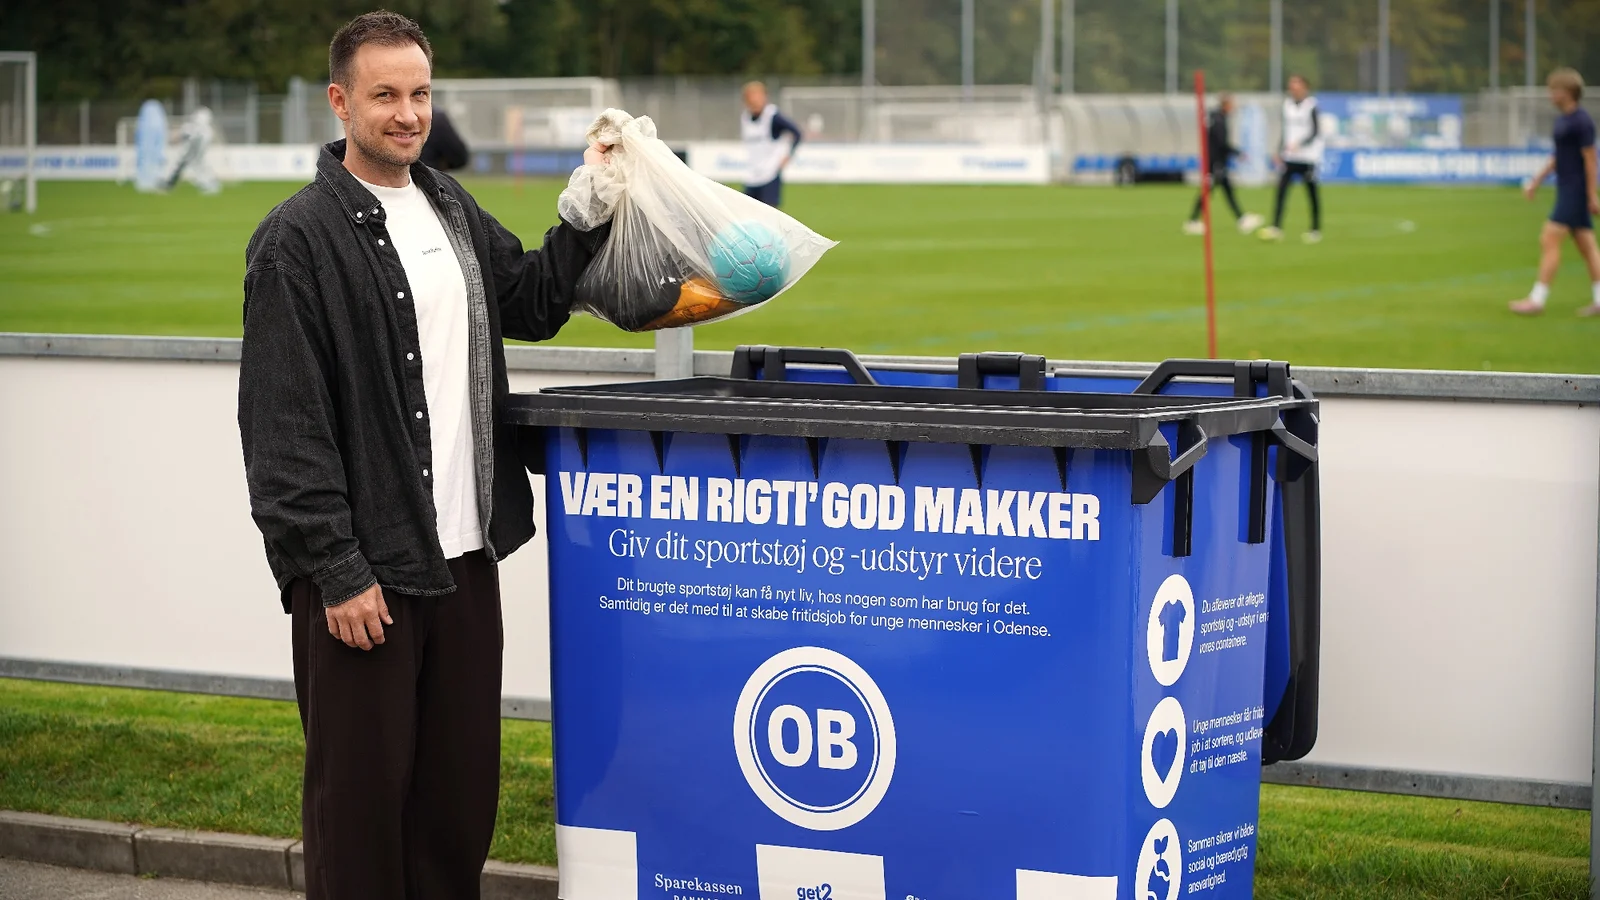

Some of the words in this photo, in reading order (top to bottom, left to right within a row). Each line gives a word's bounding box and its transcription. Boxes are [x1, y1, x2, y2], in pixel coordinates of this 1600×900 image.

[558, 471, 643, 519] VÆR
[650, 474, 699, 521] EN
[821, 481, 906, 531] GOD
[914, 485, 1100, 541] MAKKER
[609, 528, 650, 559] Giv
[655, 530, 689, 561] dit
[693, 538, 807, 574] sportstøj
[812, 545, 845, 575] og
[850, 542, 949, 581] -udstyr
[954, 546, 1042, 580] videre
[617, 577, 634, 592] Dit
[637, 578, 676, 597] brugte
[679, 583, 732, 601] sportstøj
[735, 584, 757, 599] kan
[760, 585, 772, 600] få
[776, 588, 796, 604] nyt
[799, 587, 815, 605] liv,
[818, 589, 841, 604] hos
[845, 592, 886, 608] nogen
[890, 595, 918, 609] som
[922, 594, 943, 610] har
[947, 596, 978, 615] brug
[981, 598, 1000, 613] for
[1004, 599, 1030, 615] det.
[1202, 599, 1211, 613] Du
[1236, 593, 1245, 608] dit
[599, 595, 650, 614] Samtidig
[653, 601, 666, 613] er
[669, 600, 689, 615] det
[692, 601, 719, 617] med
[722, 602, 733, 617] til
[735, 604, 748, 619] at
[751, 604, 788, 621] skabe
[791, 607, 846, 626] fritidsjob
[849, 611, 867, 626] for
[871, 614, 904, 630] unge
[908, 616, 983, 633] mennesker
[986, 618, 990, 633] i
[993, 619, 1051, 637] Odense.
[1200, 616, 1226, 636] sportstøj
[1226, 617, 1234, 631] og
[1235, 612, 1255, 628] -udstyr
[1256, 610, 1259, 623] i
[1259, 611, 1267, 623] en
[1199, 640, 1215, 654] vores
[1215, 634, 1248, 651] containere.
[1192, 719, 1208, 735] Unge
[1209, 711, 1243, 730] mennesker
[1243, 707, 1252, 722] får
[767, 704, 858, 770] OB
[1190, 738, 1200, 757] job
[1201, 738, 1204, 751] i
[1204, 738, 1211, 750] at
[1211, 733, 1235, 749] sortere,
[1235, 731, 1244, 746] og
[1190, 759, 1198, 774] dit
[1199, 757, 1207, 774] tøj
[1214, 753, 1226, 768] den
[1227, 749, 1248, 765] næste.
[1188, 836, 1215, 853] Sammen
[1215, 830, 1233, 846] sikrer
[1234, 826, 1240, 840] vi
[1240, 822, 1255, 839] både
[1188, 855, 1206, 874] social
[1206, 856, 1215, 870] og
[1215, 843, 1249, 866] bæredygtig
[654, 873, 743, 895] Sparekassen
[1187, 869, 1227, 894] ansvarlighed.
